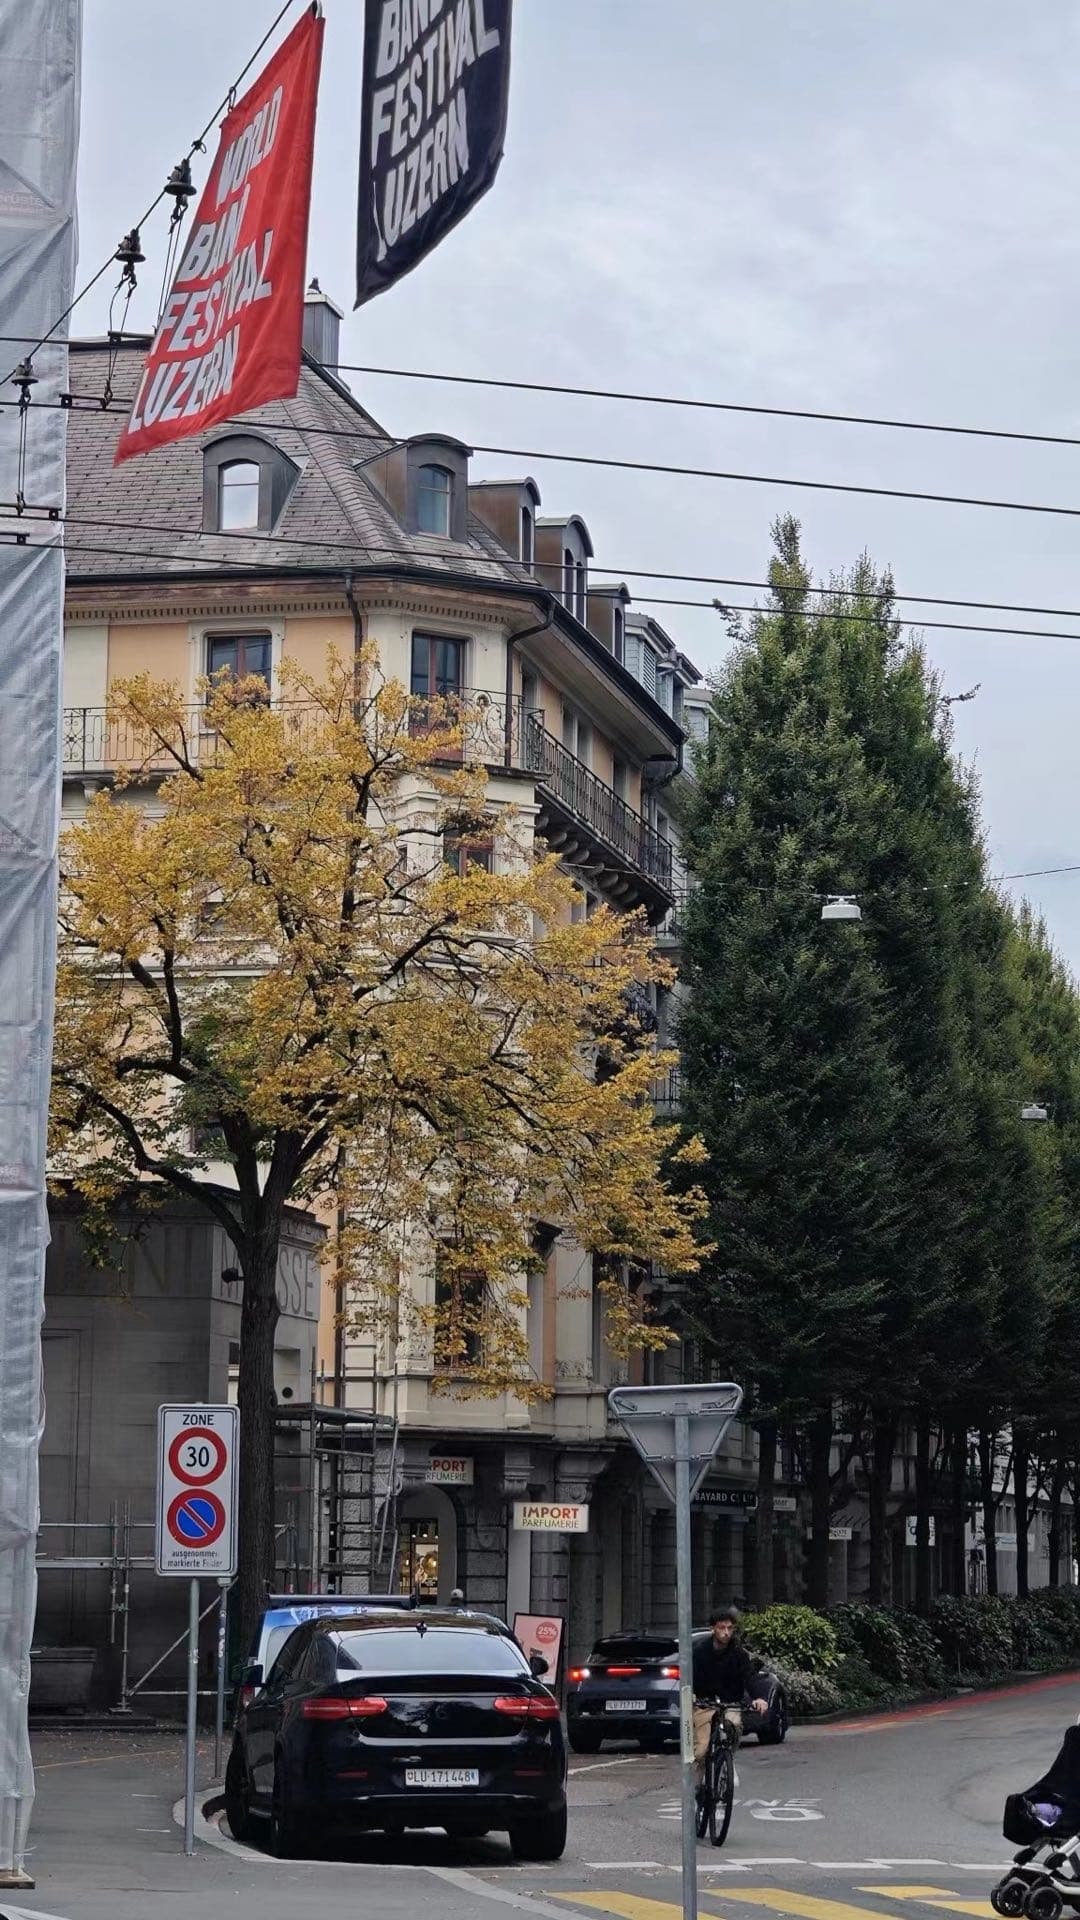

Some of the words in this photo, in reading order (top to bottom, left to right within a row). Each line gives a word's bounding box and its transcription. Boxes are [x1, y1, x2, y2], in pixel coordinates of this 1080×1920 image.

[371, 0, 501, 169] FESTIVAL
[127, 324, 240, 435] LUZERN
[182, 1414, 215, 1426] ZONE
[186, 1446, 210, 1468] 30
[429, 1459, 467, 1472] PORT
[425, 1471, 467, 1482] RFUMERIE
[522, 1506, 579, 1519] IMPORT
[522, 1518, 579, 1529] PARFUMERIE
